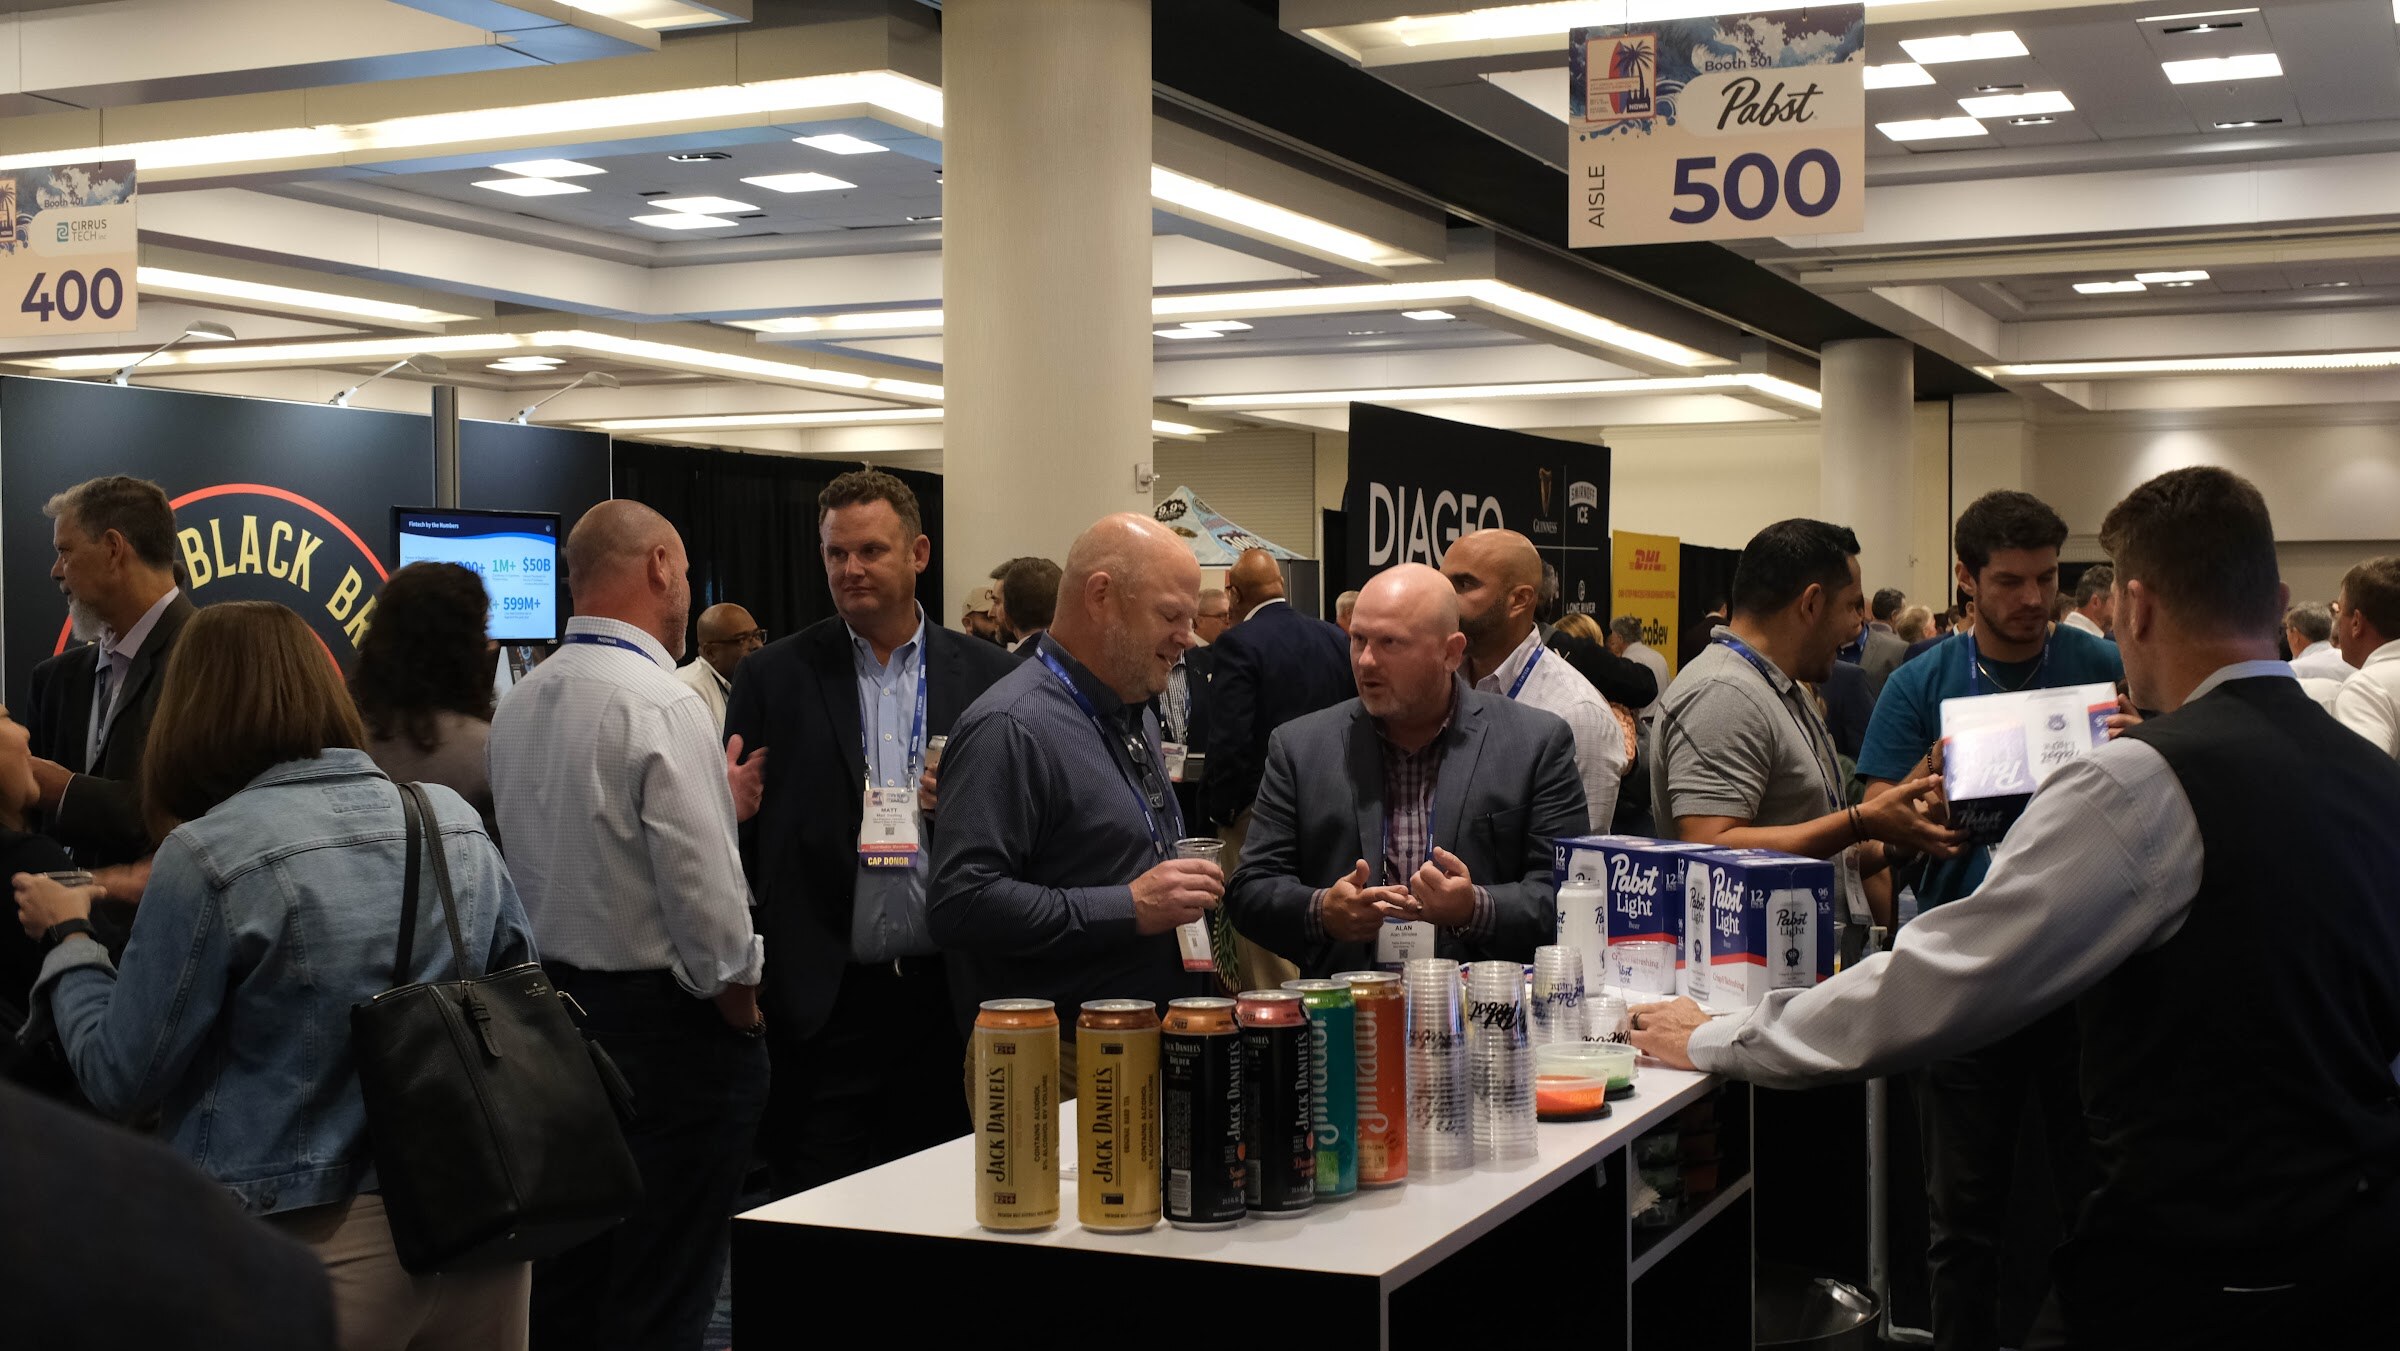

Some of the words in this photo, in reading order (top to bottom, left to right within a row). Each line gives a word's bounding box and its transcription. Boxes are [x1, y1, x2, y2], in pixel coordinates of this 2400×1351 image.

[1704, 58, 1747, 72] Booth
[1751, 56, 1772, 68] 501
[1716, 76, 1824, 130] Pabst
[1589, 165, 1605, 228] AISLE
[1669, 148, 1841, 224] 500
[44, 198, 68, 208] Booth
[70, 197, 84, 206] 401
[71, 219, 107, 231] CIRRUS
[73, 231, 97, 242] TECH
[21, 267, 123, 322] 400
[408, 520, 425, 528] Fintech
[426, 521, 431, 529] by
[1577, 506, 1589, 524] ICE
[492, 559, 516, 573] 1M+
[523, 556, 551, 573] $50B
[1634, 549, 1662, 571] DHL
[177, 515, 324, 593] BLACK
[326, 565, 378, 649] BR
[503, 597, 541, 611] 599M+
[1566, 602, 1581, 614] LONE
[1581, 602, 1596, 614] RIVER
[868, 857, 882, 866] CAP
[884, 857, 909, 865] DONOR
[1555, 846, 1566, 861] 12
[1611, 853, 1660, 897] Pabst
[1678, 858, 1685, 874] 12
[1666, 874, 1677, 884] 12
[1712, 866, 1745, 914] Pabst
[1690, 887, 1706, 911] Pabst
[1751, 890, 1764, 901] 12
[1818, 888, 1829, 897] 96
[1617, 892, 1653, 919] Light
[1716, 909, 1740, 937] Light
[1777, 909, 1808, 927] Pabst
[1780, 926, 1805, 938] Light
[1227, 1040, 1241, 1100] DANIEL'S
[1295, 1031, 1308, 1091] DANIEL'S
[986, 1066, 1005, 1133] DANIEL'S
[1093, 1066, 1112, 1133] DANIEL'S
[1227, 1103, 1241, 1141] JACK
[1295, 1093, 1309, 1130] JACK
[986, 1138, 1006, 1182] JACK
[1093, 1138, 1113, 1182] JACK
